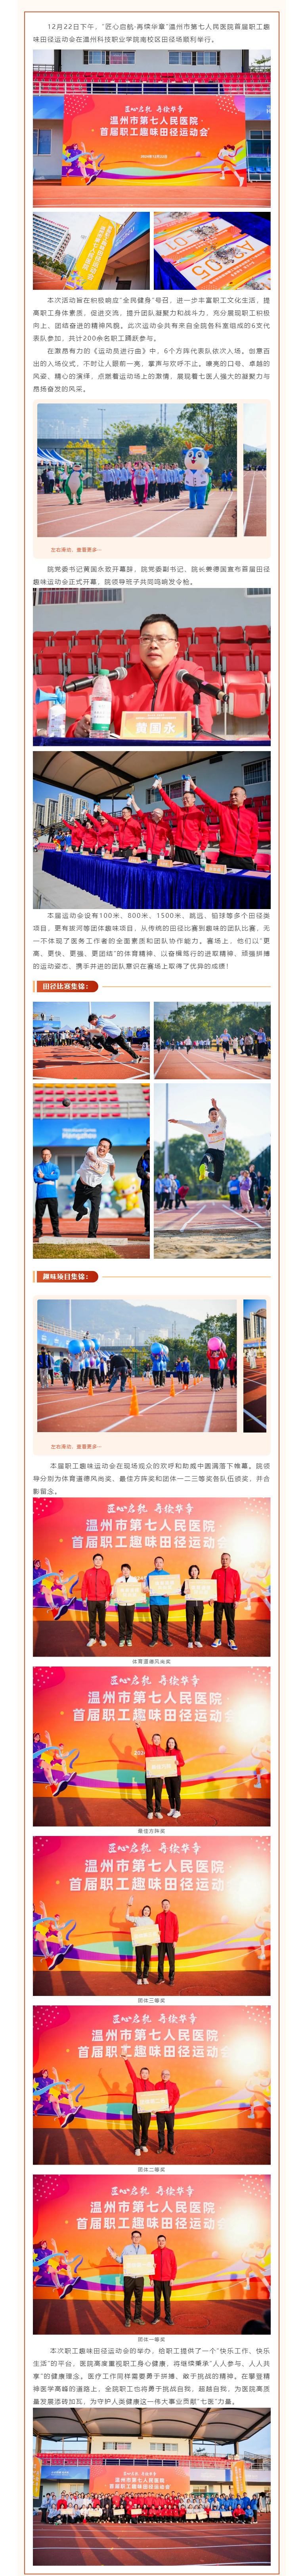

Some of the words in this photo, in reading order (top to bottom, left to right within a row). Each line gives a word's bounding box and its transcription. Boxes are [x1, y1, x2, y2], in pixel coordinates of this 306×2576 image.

[156, 105, 184, 114] 再续华章
[110, 116, 198, 125] 温州市第七人民医院
[100, 127, 208, 137] 首届职工趣味田径运动会
[114, 226, 134, 248] Hangzhou
[82, 226, 103, 271] 温州市第七人民医院
[87, 225, 113, 281] 首届职工趣味田径运动会
[136, 722, 176, 734] 黄国永
[107, 1504, 148, 1514] 匠心启航
[154, 1503, 194, 1515] 再续华章
[86, 1519, 216, 1532] 温州市第七人民医院
[72, 1535, 229, 1549] 首届职工趣味田径运动会
[110, 1676, 152, 1686] 匠心启航
[158, 1674, 200, 1687] 再续华章
[88, 1691, 222, 1705] 温州市第七人民医院
[73, 1708, 237, 1722] 首届职工趣味田径运动会
[108, 1843, 151, 1854] 匠心启航
[158, 1842, 201, 1855] 再续华章
[85, 1859, 224, 1873] 温州市第七人民医院
[112, 2014, 151, 2024] 匠心启航
[158, 2013, 197, 2025] 再续华章
[92, 2028, 219, 2041] 温州市第七人民医院
[78, 2045, 232, 2058] 首届职工趣味田径运动会
[111, 2186, 149, 2196] 匠心启航
[156, 2185, 194, 2197] 再续华章
[90, 2201, 215, 2214] 温州市第七人民医院
[76, 2217, 228, 2230] 首届职工趣味田径运动会
